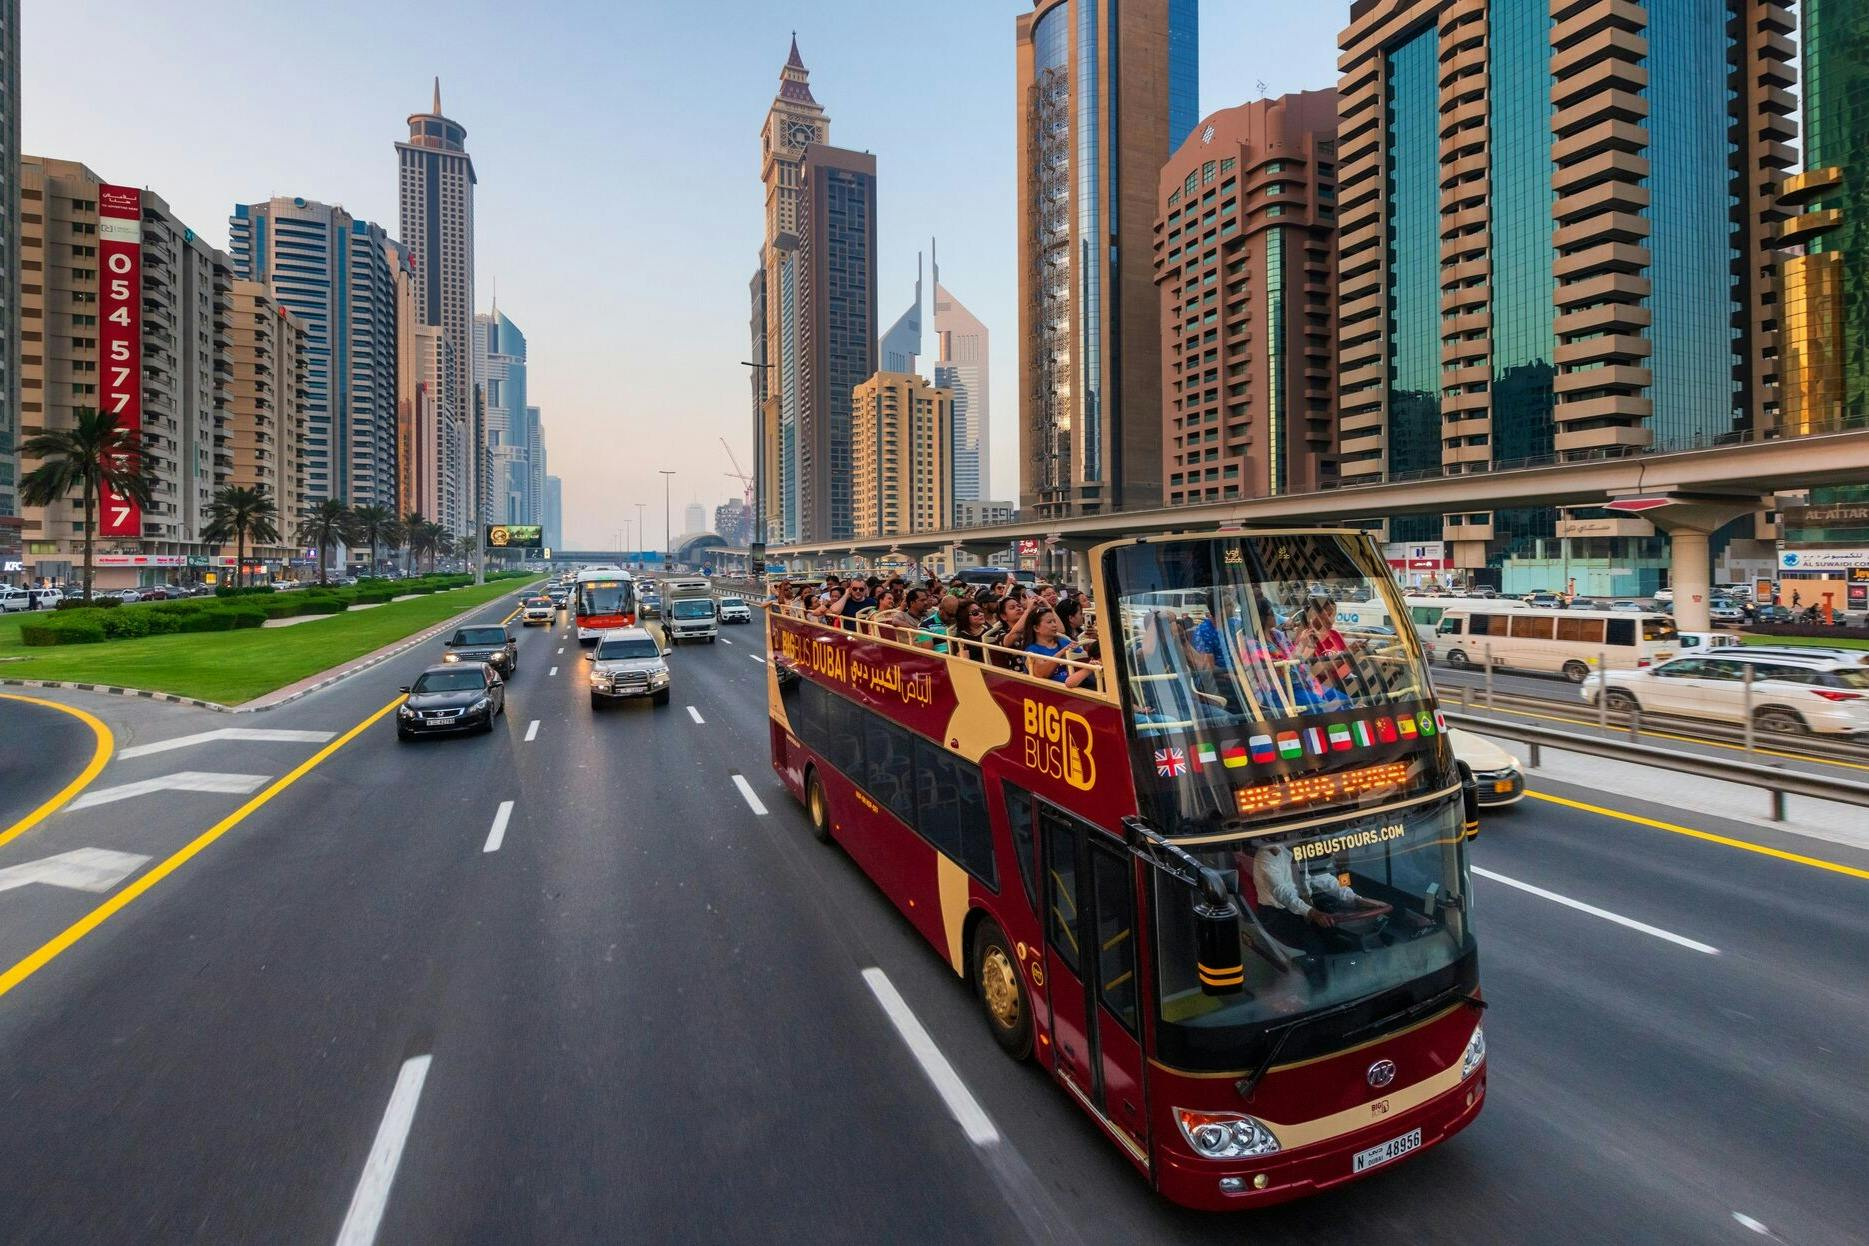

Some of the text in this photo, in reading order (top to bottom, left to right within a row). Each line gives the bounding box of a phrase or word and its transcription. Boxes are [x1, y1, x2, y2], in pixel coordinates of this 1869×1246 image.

[4, 561, 23, 571] KFC
[812, 641, 847, 683] DUBAI
[1024, 698, 1060, 743] BIG
[1025, 735, 1062, 779] BUS
[1293, 823, 1404, 861] BIGBUSTOURS.COM
[1386, 1131, 1420, 1158] 48956
[1357, 1154, 1365, 1170] N
[1368, 1156, 1384, 1166] DUBAI
